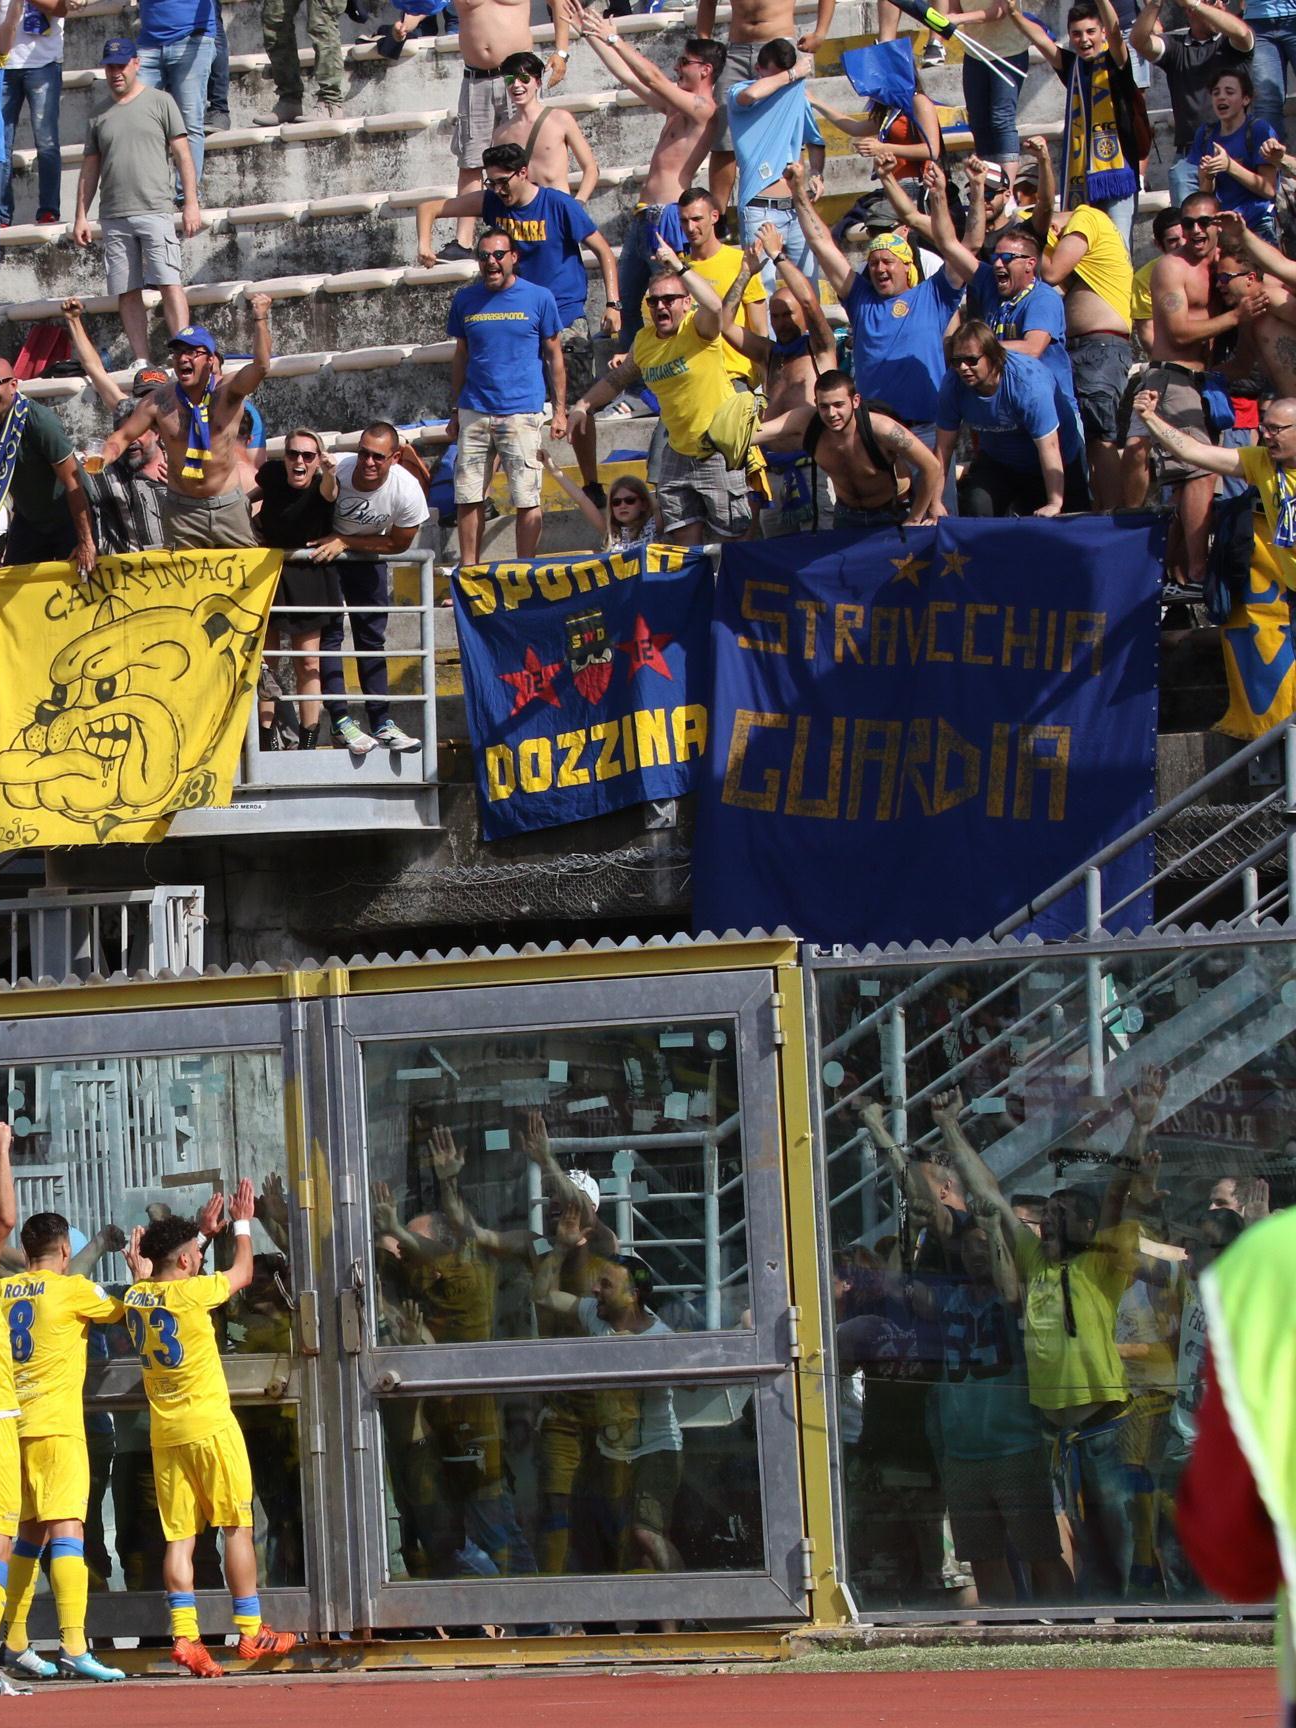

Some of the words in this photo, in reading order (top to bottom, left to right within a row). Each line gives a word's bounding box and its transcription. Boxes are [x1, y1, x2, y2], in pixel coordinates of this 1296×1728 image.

[485, 703, 709, 802] DOZZINA
[721, 708, 1072, 821] GUARDIA
[8, 1300, 37, 1364] 8
[125, 1306, 184, 1369] 23
